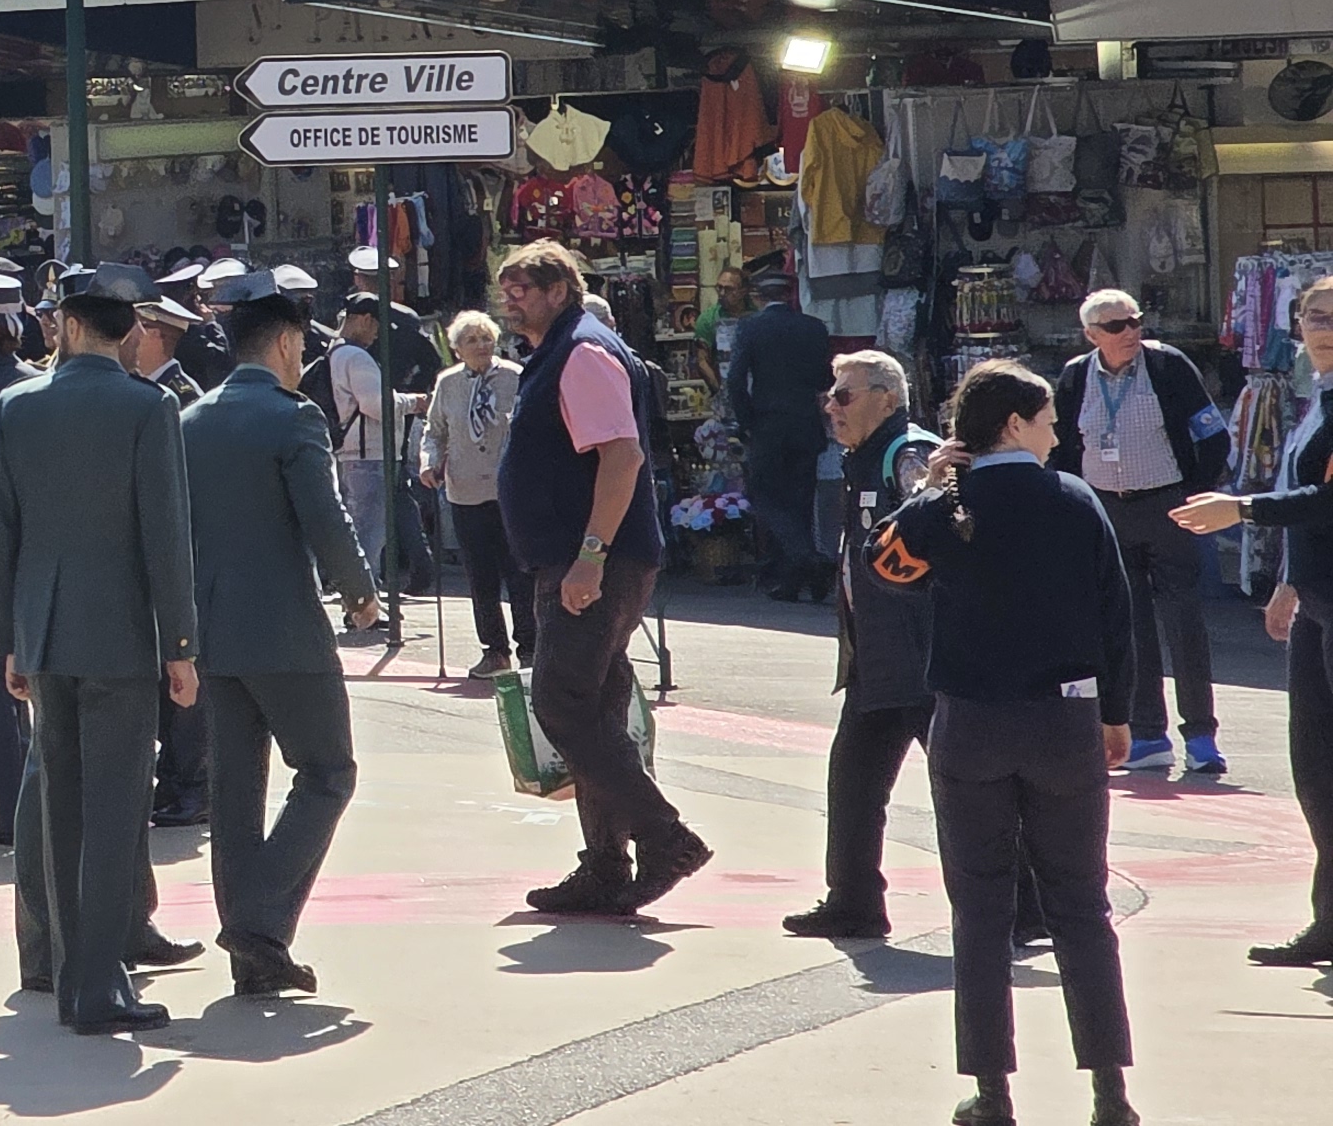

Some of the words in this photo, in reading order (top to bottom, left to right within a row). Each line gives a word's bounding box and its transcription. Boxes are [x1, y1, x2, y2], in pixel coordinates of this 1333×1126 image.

[277, 67, 389, 97] Centre
[403, 64, 474, 93] Ville
[289, 126, 352, 149] OFFICE
[358, 127, 381, 146] DE
[388, 124, 478, 145] TOURISME
